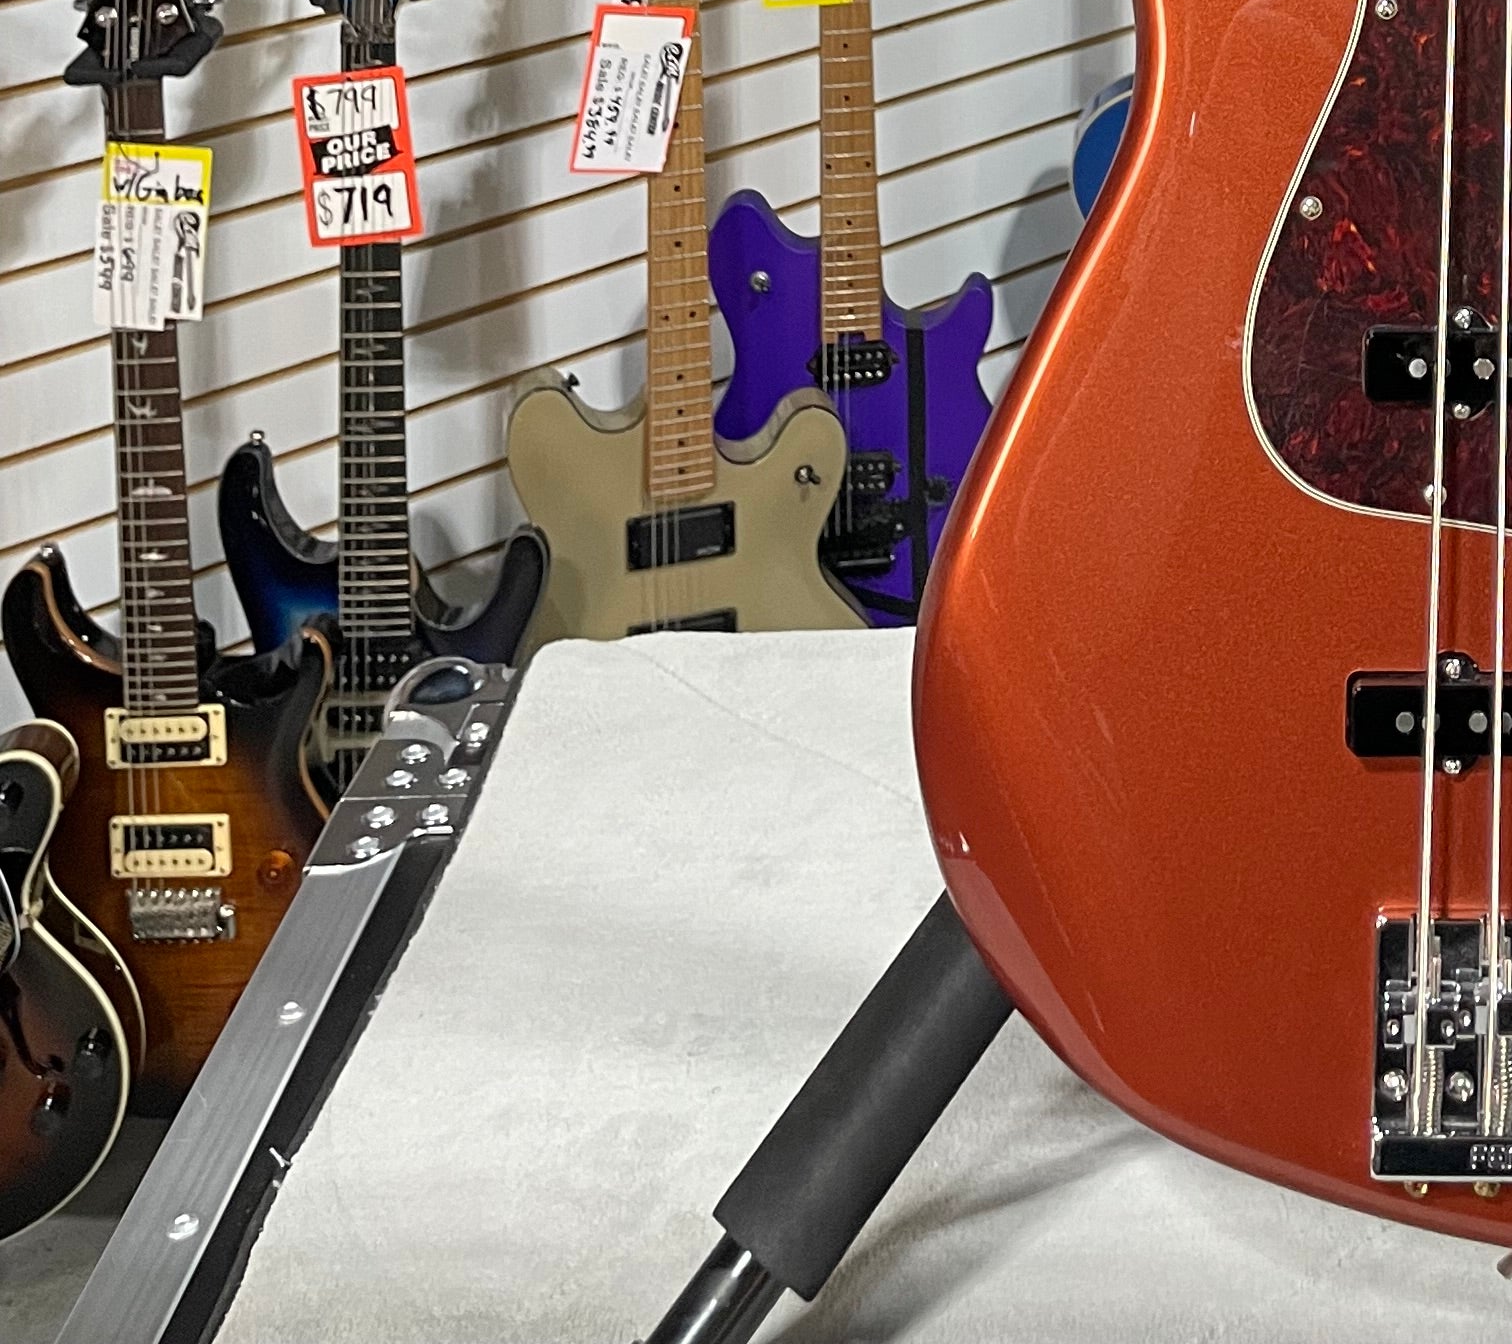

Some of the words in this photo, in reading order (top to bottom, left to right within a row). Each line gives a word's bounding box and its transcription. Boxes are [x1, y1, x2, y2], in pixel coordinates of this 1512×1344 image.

[596, 58, 612, 92] Sale
[321, 144, 392, 175] PRICE
[326, 131, 376, 156] OUR
[102, 204, 115, 240] Sale
[317, 185, 394, 229] $719
